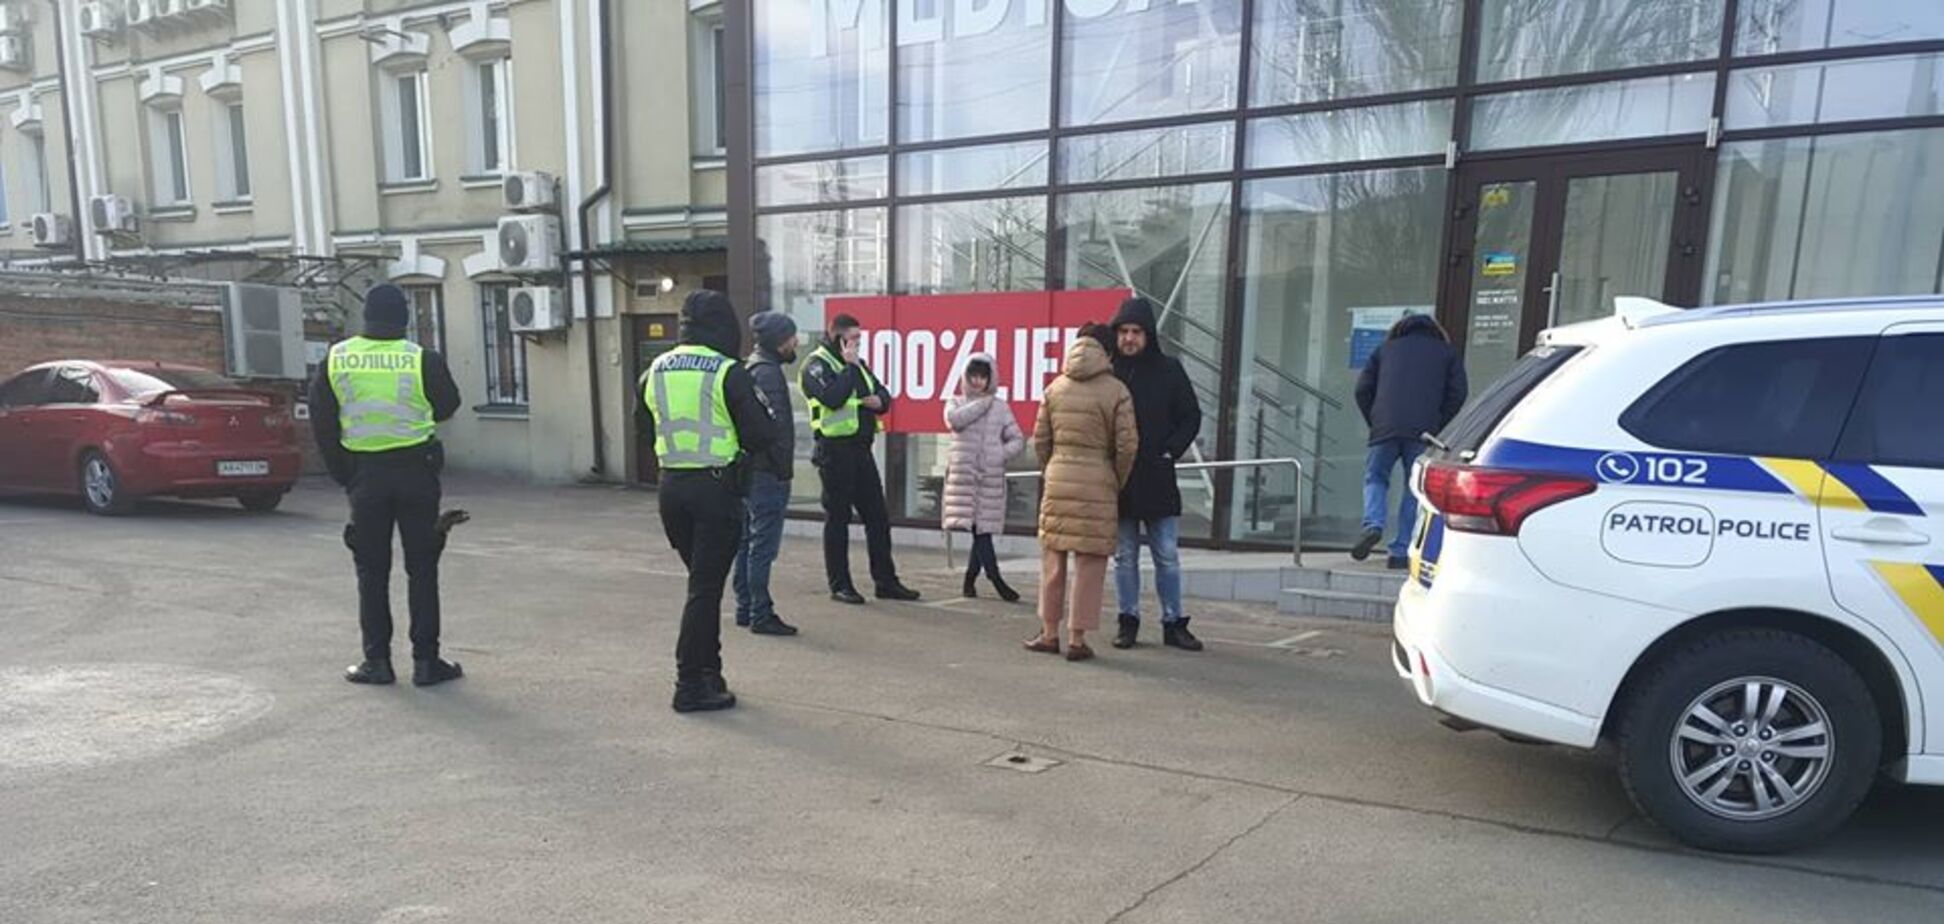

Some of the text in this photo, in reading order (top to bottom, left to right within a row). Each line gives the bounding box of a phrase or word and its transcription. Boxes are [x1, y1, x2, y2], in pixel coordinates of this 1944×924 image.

[333, 354, 416, 372] ПОЛІЦІЯ
[1646, 455, 1708, 485] 102
[1609, 513, 1811, 541] PATROL POLICE
